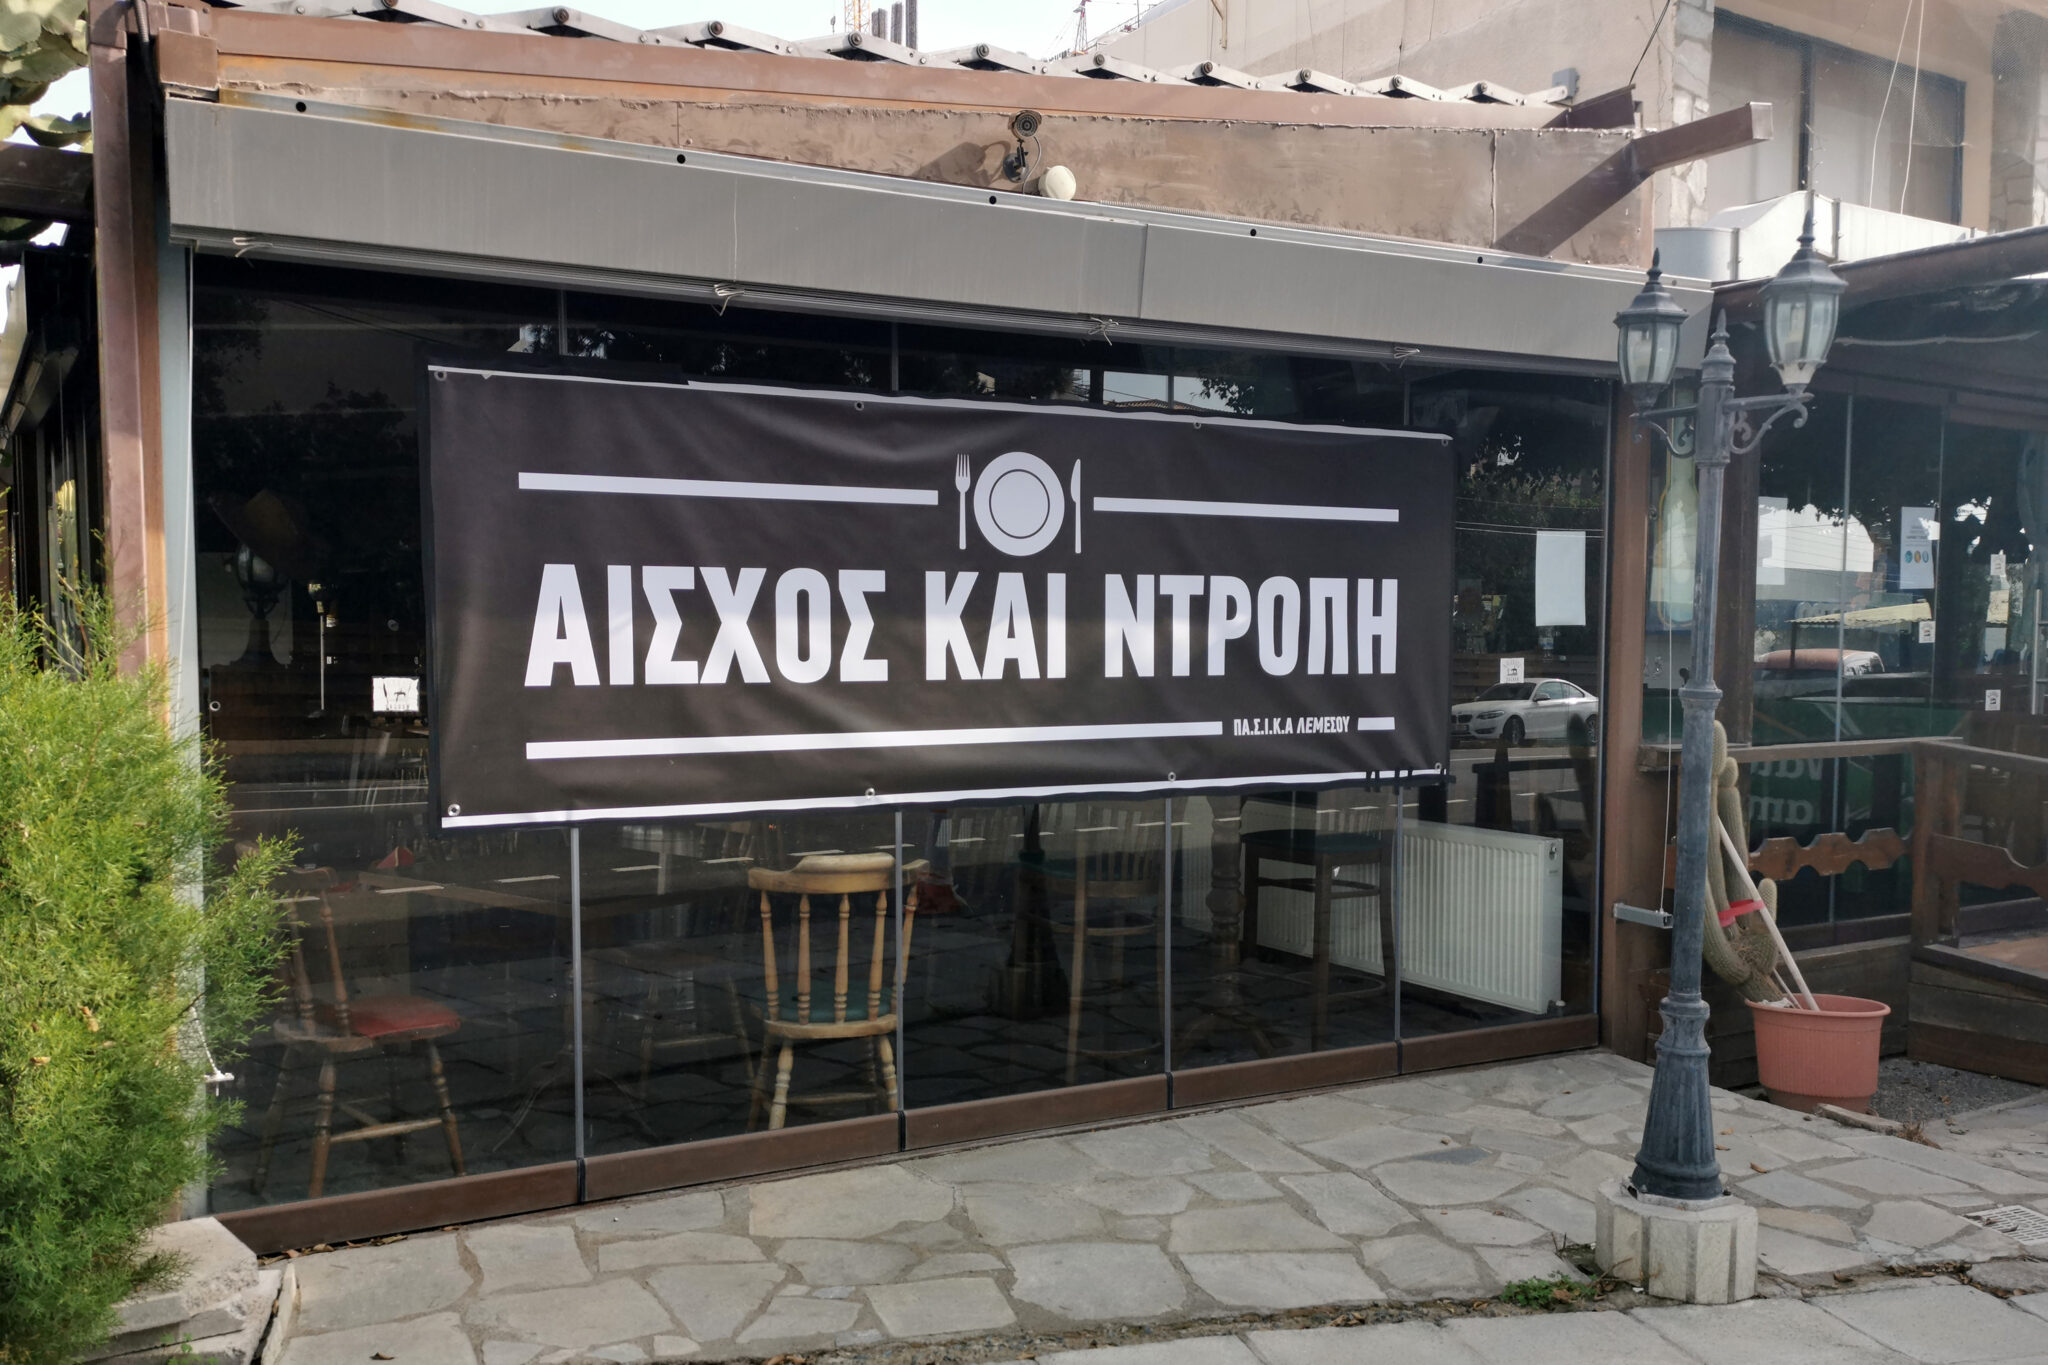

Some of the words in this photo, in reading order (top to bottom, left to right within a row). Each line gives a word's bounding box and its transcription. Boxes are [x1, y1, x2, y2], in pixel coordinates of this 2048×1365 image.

[524, 564, 888, 686] ΑΙΣΧΟΣ
[926, 571, 1066, 680] ΚΑΙ
[1105, 574, 1397, 677] ΝΤΡΟΠΗ
[1297, 716, 1350, 733] ΛΕΜΕΣΟΥ
